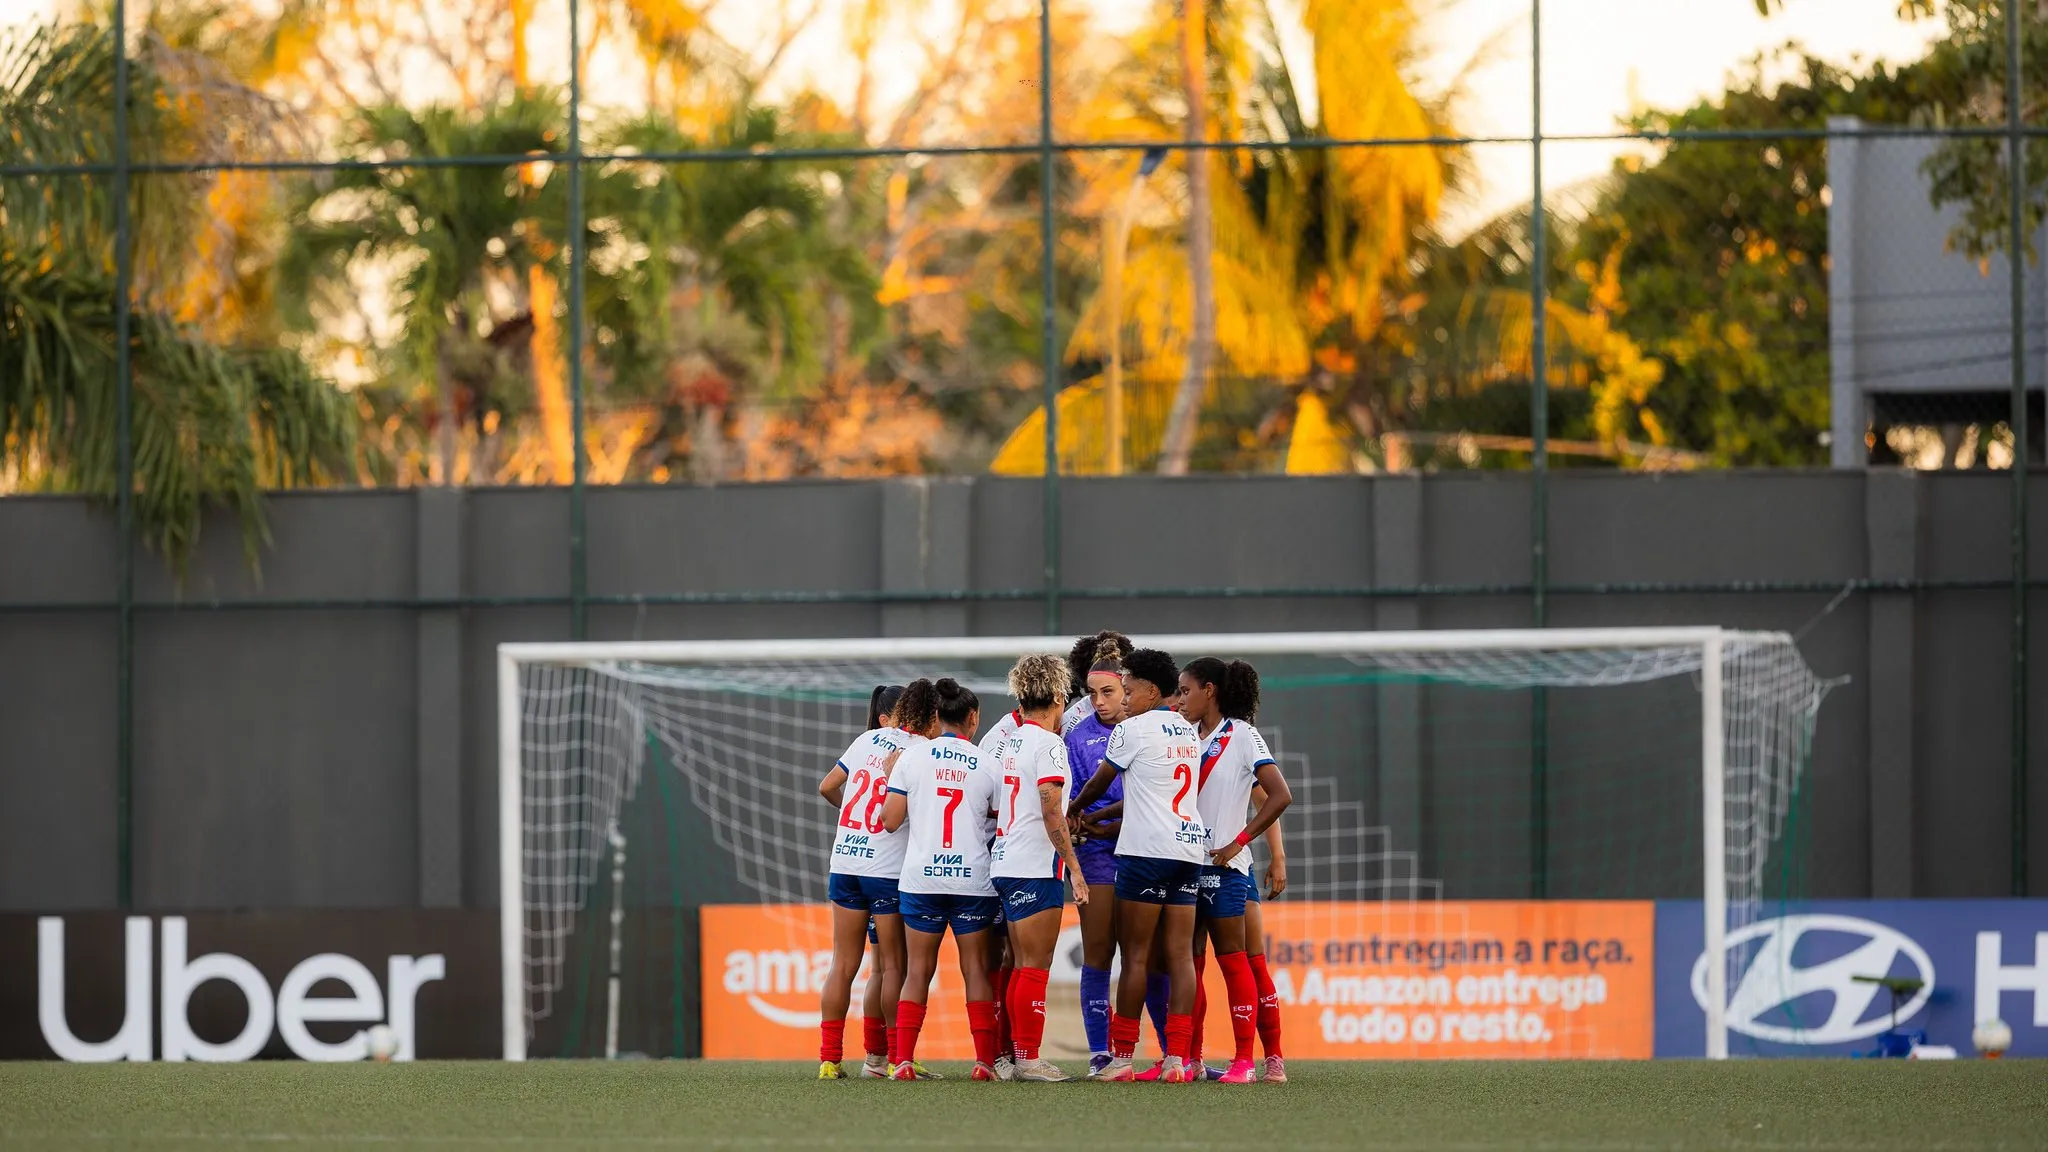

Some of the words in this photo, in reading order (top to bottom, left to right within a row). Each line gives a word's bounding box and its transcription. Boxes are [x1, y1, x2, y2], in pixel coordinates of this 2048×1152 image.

[1171, 724, 1197, 742] bmg
[943, 746, 978, 771] bmg
[1167, 746, 1175, 759] D.
[1176, 746, 1198, 759] NUNES
[935, 768, 968, 783] WENDY
[1172, 763, 1192, 821] 2
[839, 768, 888, 835] 28
[937, 787, 964, 849] 7
[835, 844, 875, 859] SORTE
[923, 866, 972, 878] SORTE
[1265, 935, 1314, 964] las
[1324, 935, 1504, 971] entregam
[1514, 938, 1533, 963] a
[1543, 938, 1633, 971] raça.
[38, 916, 445, 1062] Uber
[1272, 968, 1298, 1005] A
[1299, 968, 1450, 1005] Amazon
[1456, 967, 1608, 1011] entrega
[1319, 1008, 1406, 1043] todo
[1412, 1012, 1436, 1043] o
[1441, 1007, 1552, 1043] resto.
